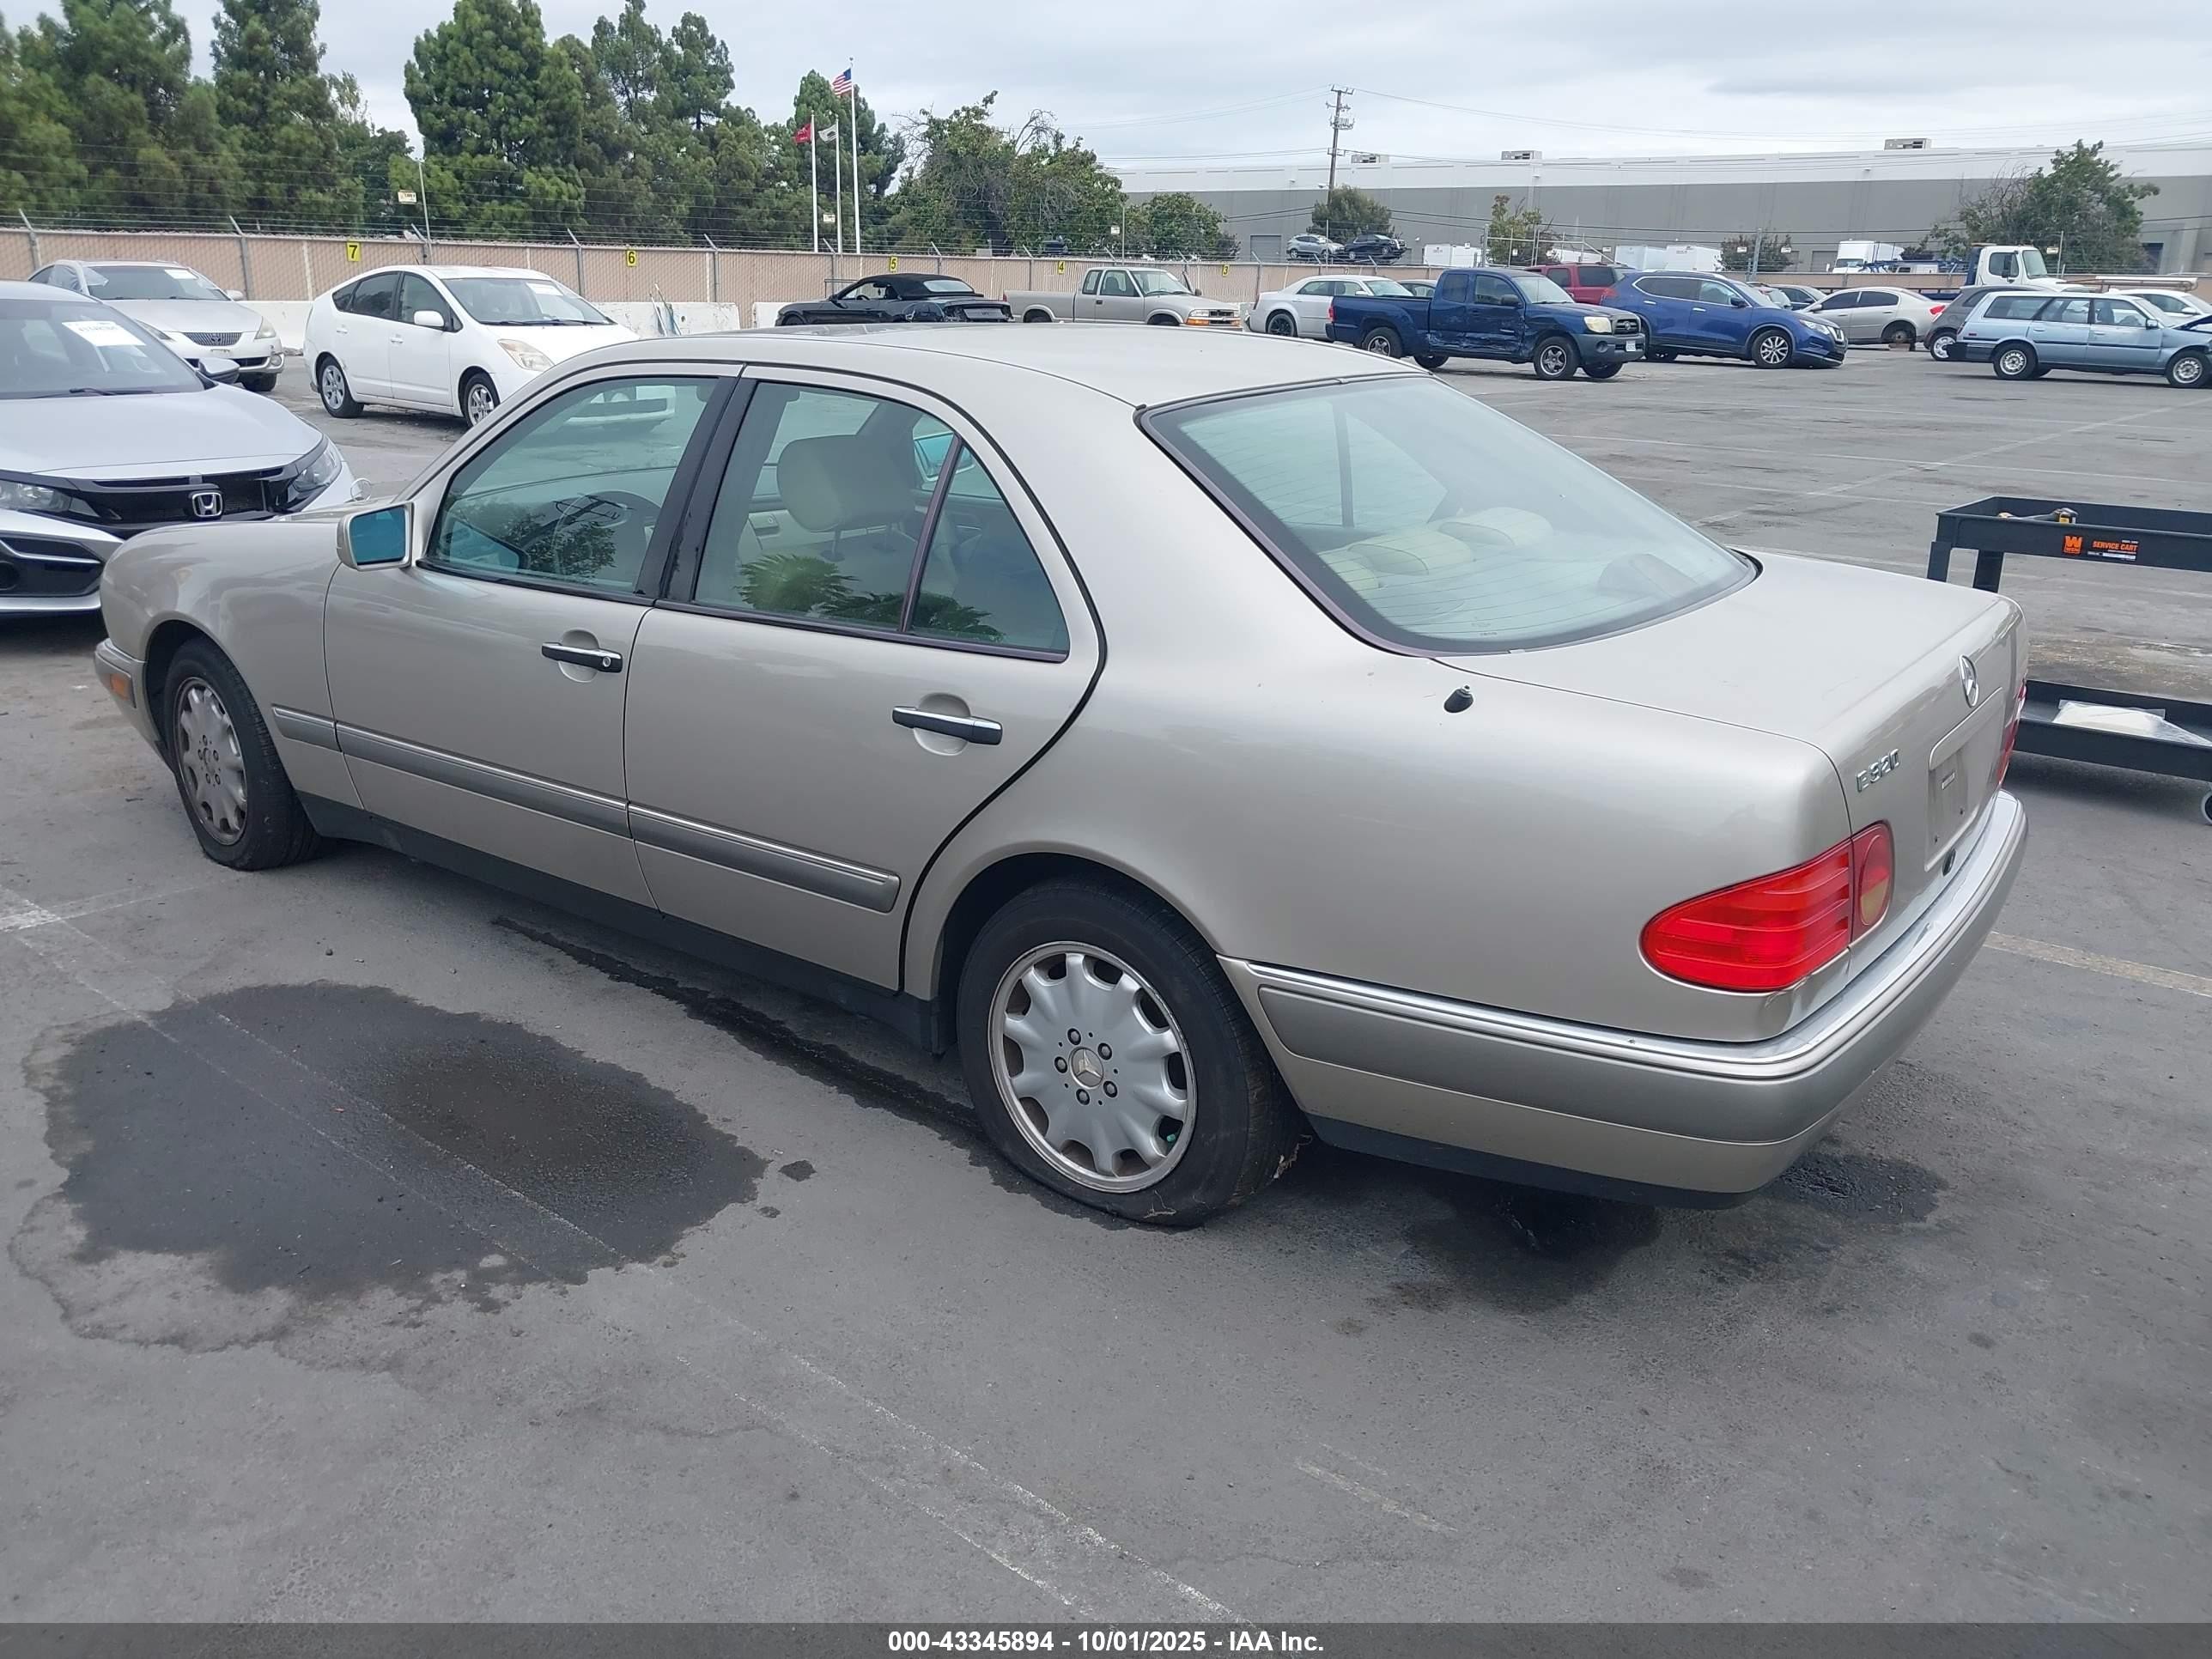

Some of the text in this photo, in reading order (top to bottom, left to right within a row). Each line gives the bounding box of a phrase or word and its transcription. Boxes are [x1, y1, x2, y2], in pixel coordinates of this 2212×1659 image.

[349, 245, 358, 258] 7
[628, 252, 635, 264] 6
[890, 258, 896, 270] 5
[1059, 262, 1064, 272] 4
[1223, 266, 1229, 275] 3
[2092, 540, 2120, 550] SERVICE
[2120, 544, 2138, 552] CART
[1856, 748, 1899, 793] E320
